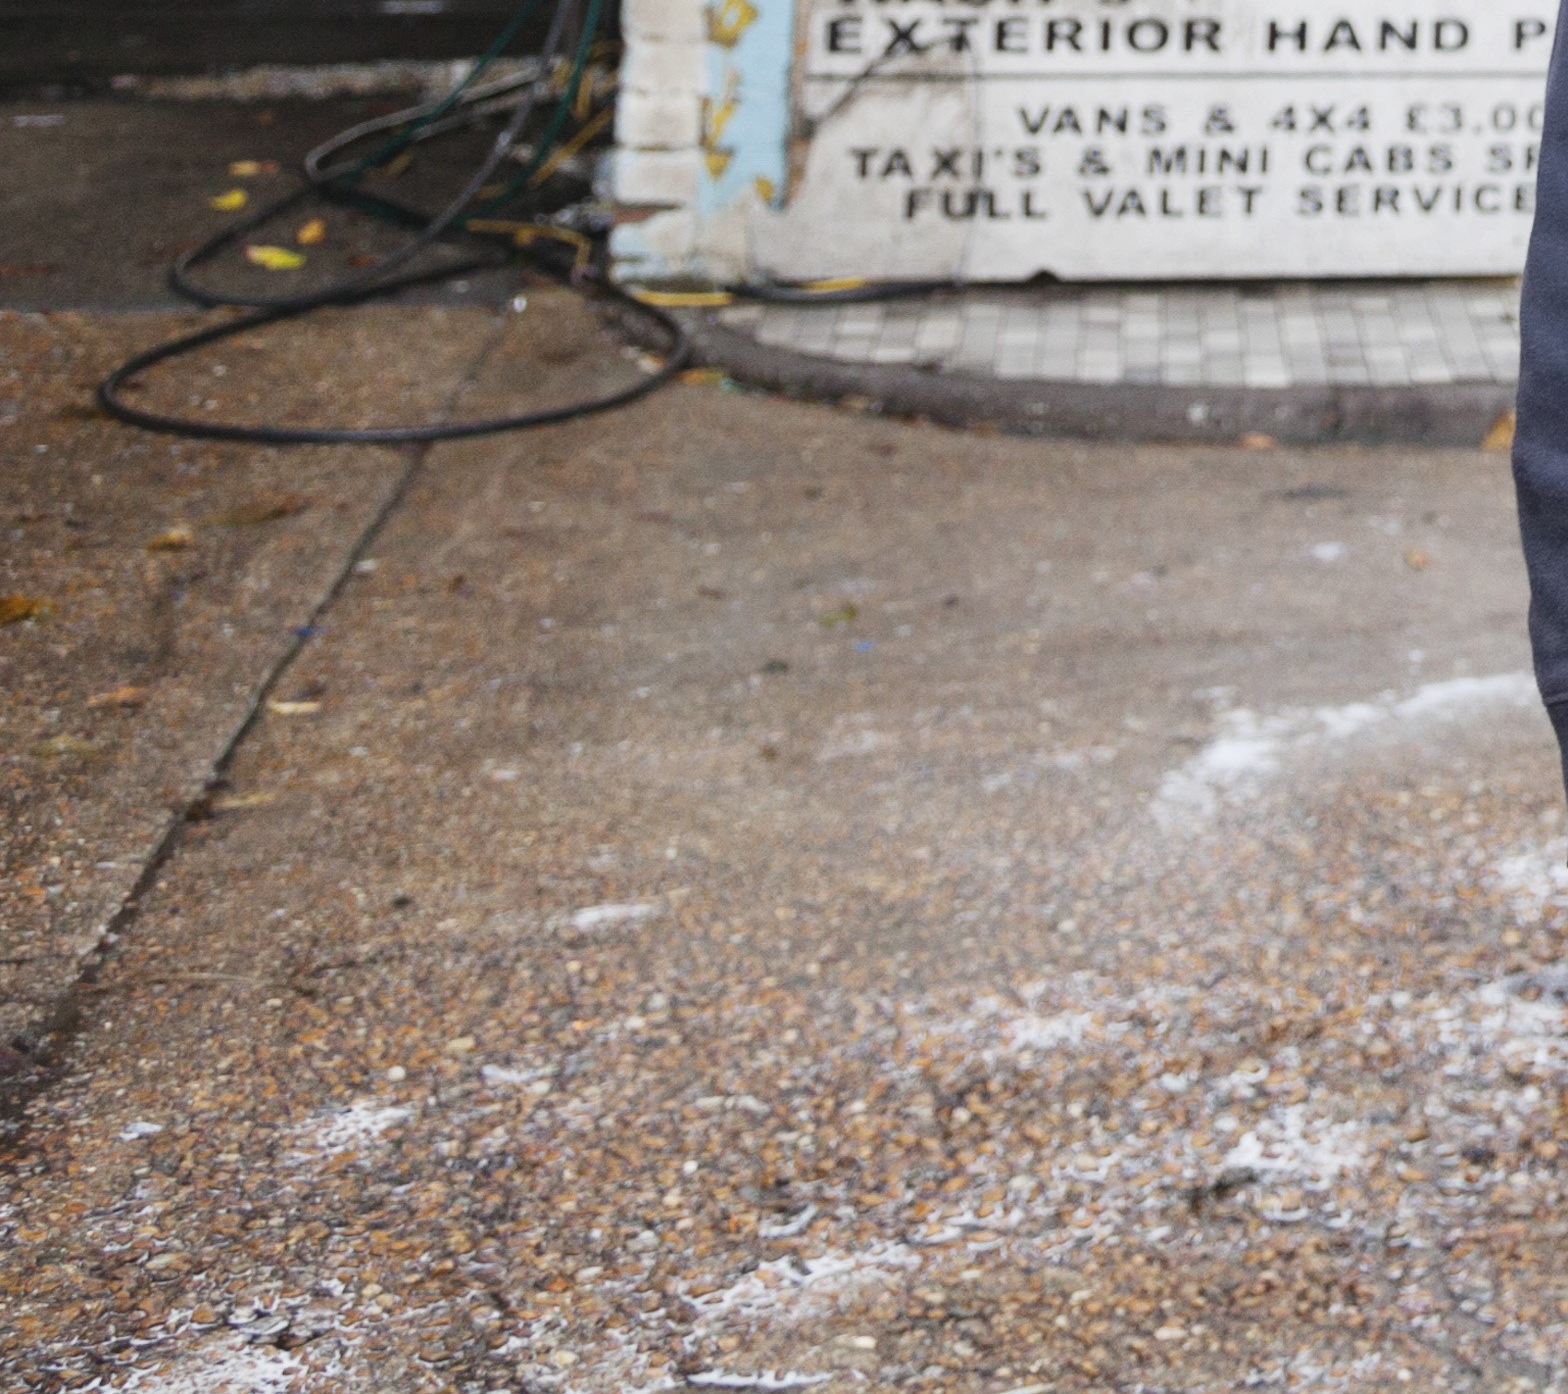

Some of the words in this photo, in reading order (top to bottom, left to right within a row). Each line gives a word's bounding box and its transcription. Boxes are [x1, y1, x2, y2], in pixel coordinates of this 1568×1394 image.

[826, 12, 1223, 55] EXTERIOR
[1265, 17, 1470, 54] HAND
[1018, 105, 1167, 137] VANS
[1204, 106, 1236, 136] &
[1271, 105, 1370, 133] 4X4
[1077, 147, 1112, 178] &
[1146, 145, 1269, 175] MINI
[1303, 145, 1453, 175] CABS
[902, 190, 1047, 223] FULL
[1081, 186, 1262, 220] VALET
